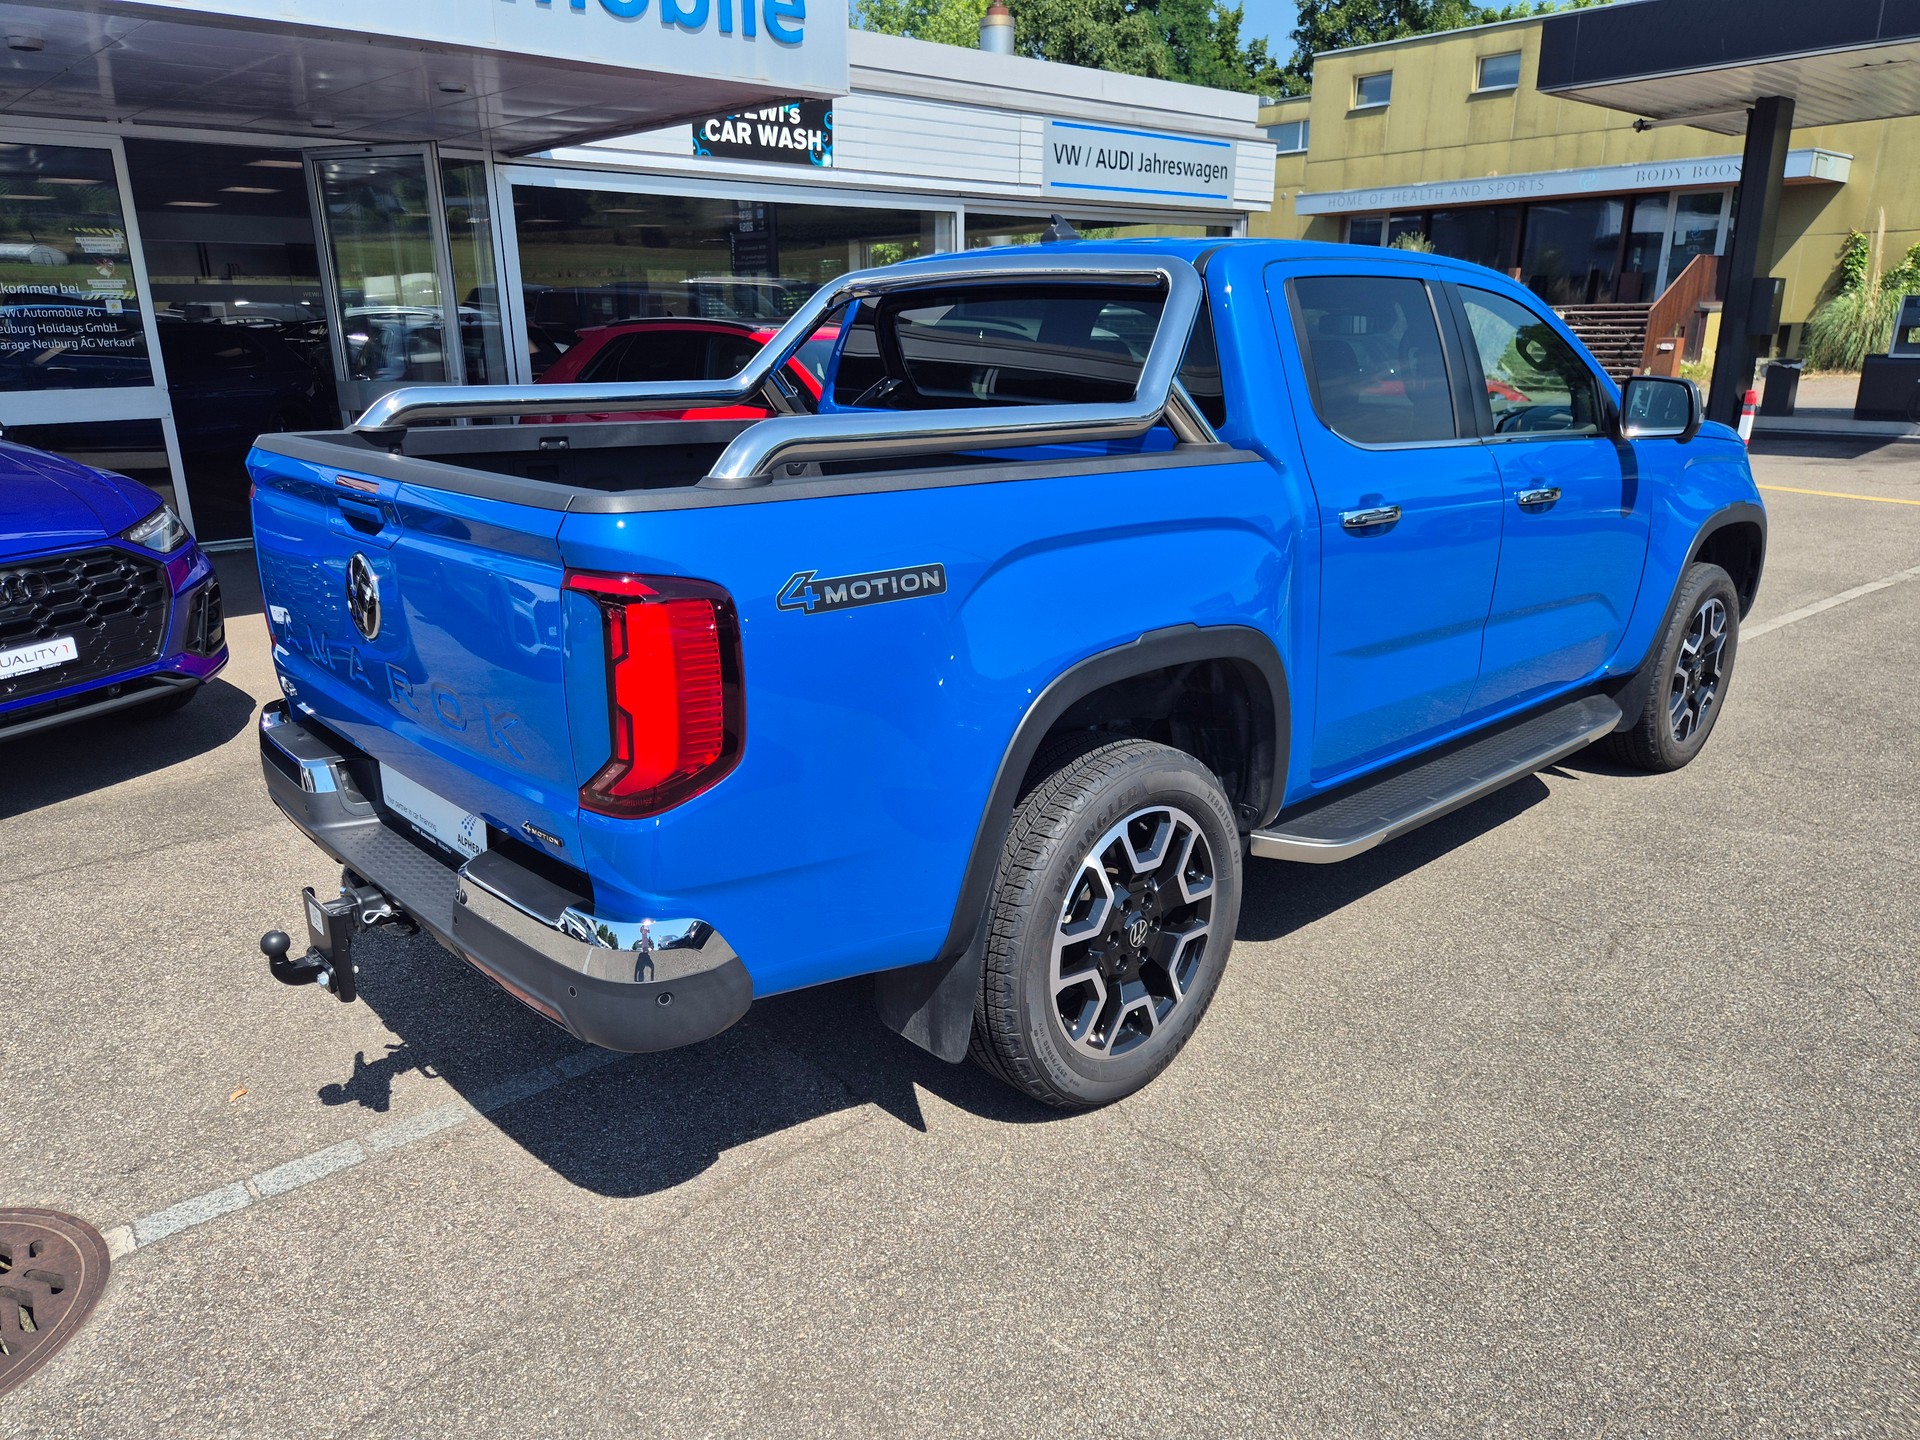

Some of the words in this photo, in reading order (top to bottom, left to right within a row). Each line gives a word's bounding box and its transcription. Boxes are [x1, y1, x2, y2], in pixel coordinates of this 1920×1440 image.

[705, 119, 752, 145] CAR
[757, 124, 822, 152] WASH
[1053, 143, 1082, 166] VW
[1085, 147, 1092, 168] /
[1096, 148, 1134, 171] AUDI
[1138, 152, 1228, 184] Jahreswagen
[1636, 166, 1686, 183] BODY
[1328, 194, 1364, 208] HOME
[1369, 192, 1386, 205] OF
[1392, 188, 1444, 203] HEALTH
[1450, 185, 1481, 199] AND
[1487, 178, 1546, 195] SPORTS
[0, 283, 58, 294] kommen
[60, 282, 80, 294] bei
[23, 308, 84, 318] Automobile
[86, 308, 101, 318] AG
[37, 323, 84, 335] Holidays
[85, 322, 118, 333] GmbH
[32, 339, 79, 351] Neuburg
[97, 337, 136, 348] Verkauf
[62, 644, 69, 654] 1
[283, 611, 526, 761] AMAROK
[1206, 790, 1236, 842] TERRITORY
[1053, 785, 1139, 893] WRANGLER
